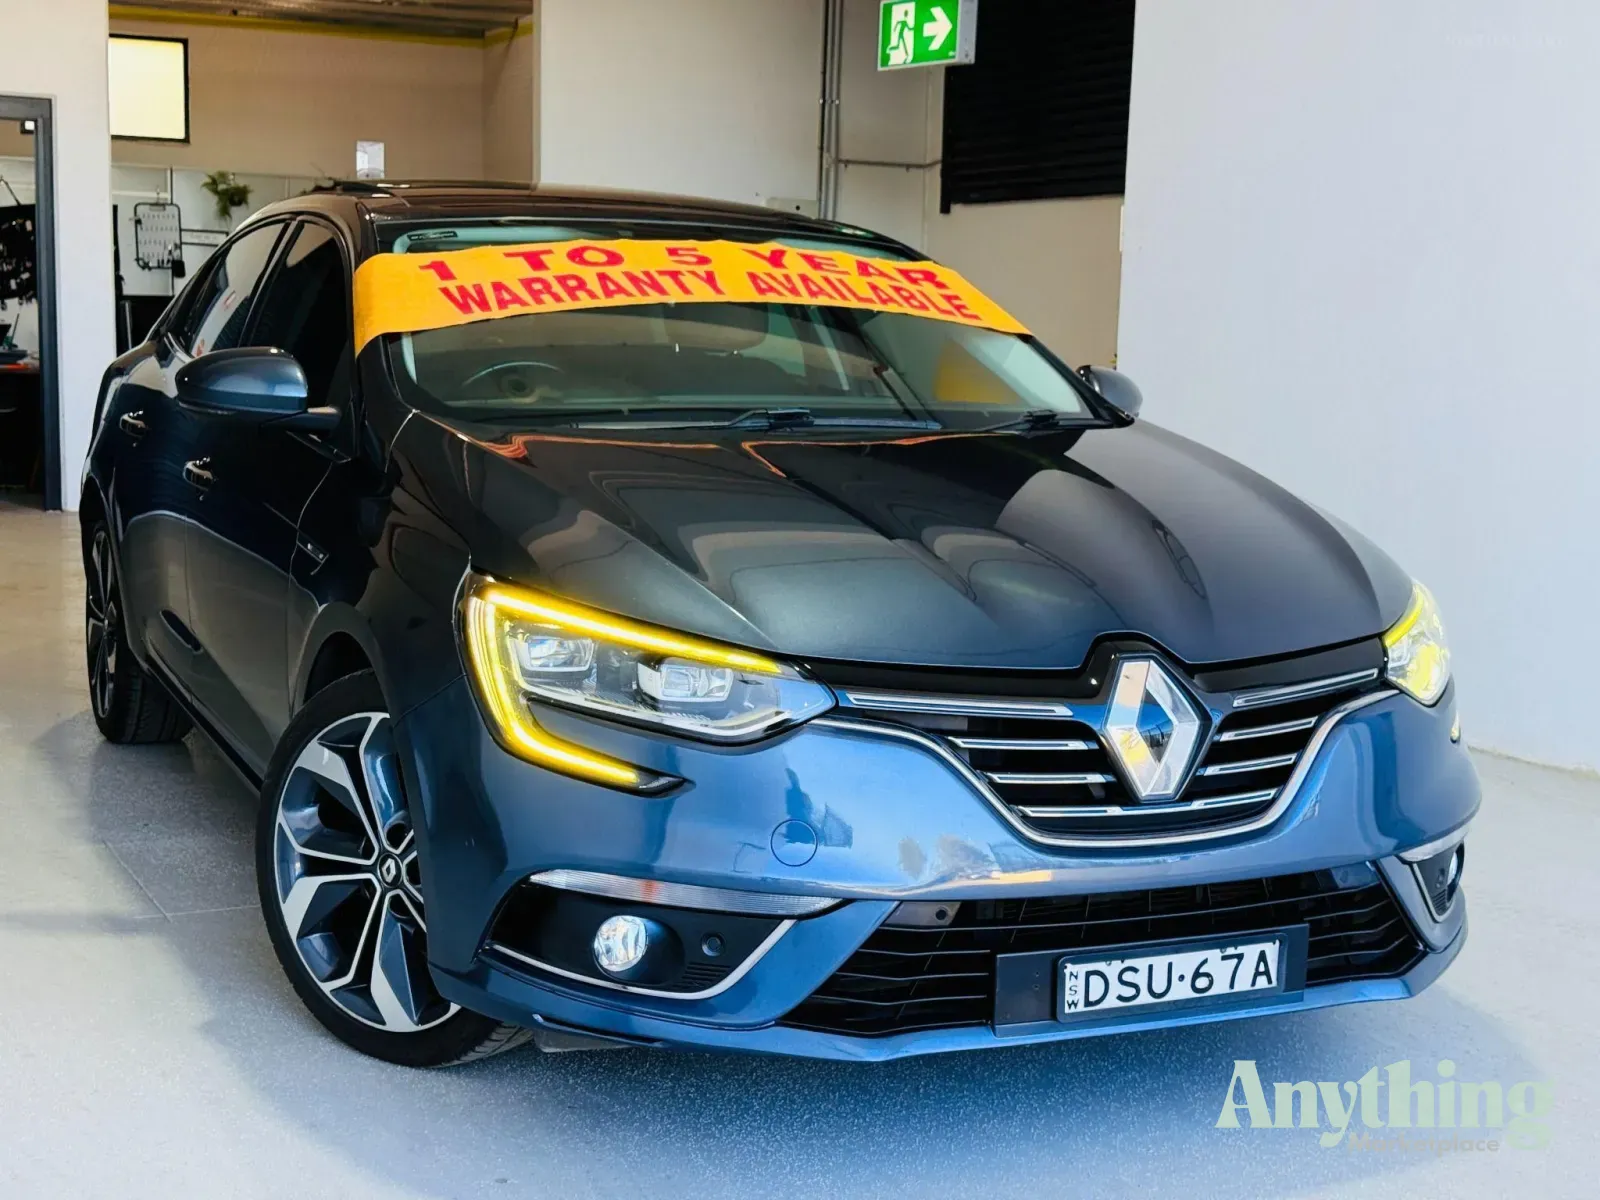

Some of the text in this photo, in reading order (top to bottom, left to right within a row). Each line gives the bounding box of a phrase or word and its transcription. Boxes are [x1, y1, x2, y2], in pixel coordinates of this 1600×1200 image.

[418, 245, 951, 290] 1 TO 5 YEAR
[438, 269, 983, 321] WARRANTY AVAILABLE
